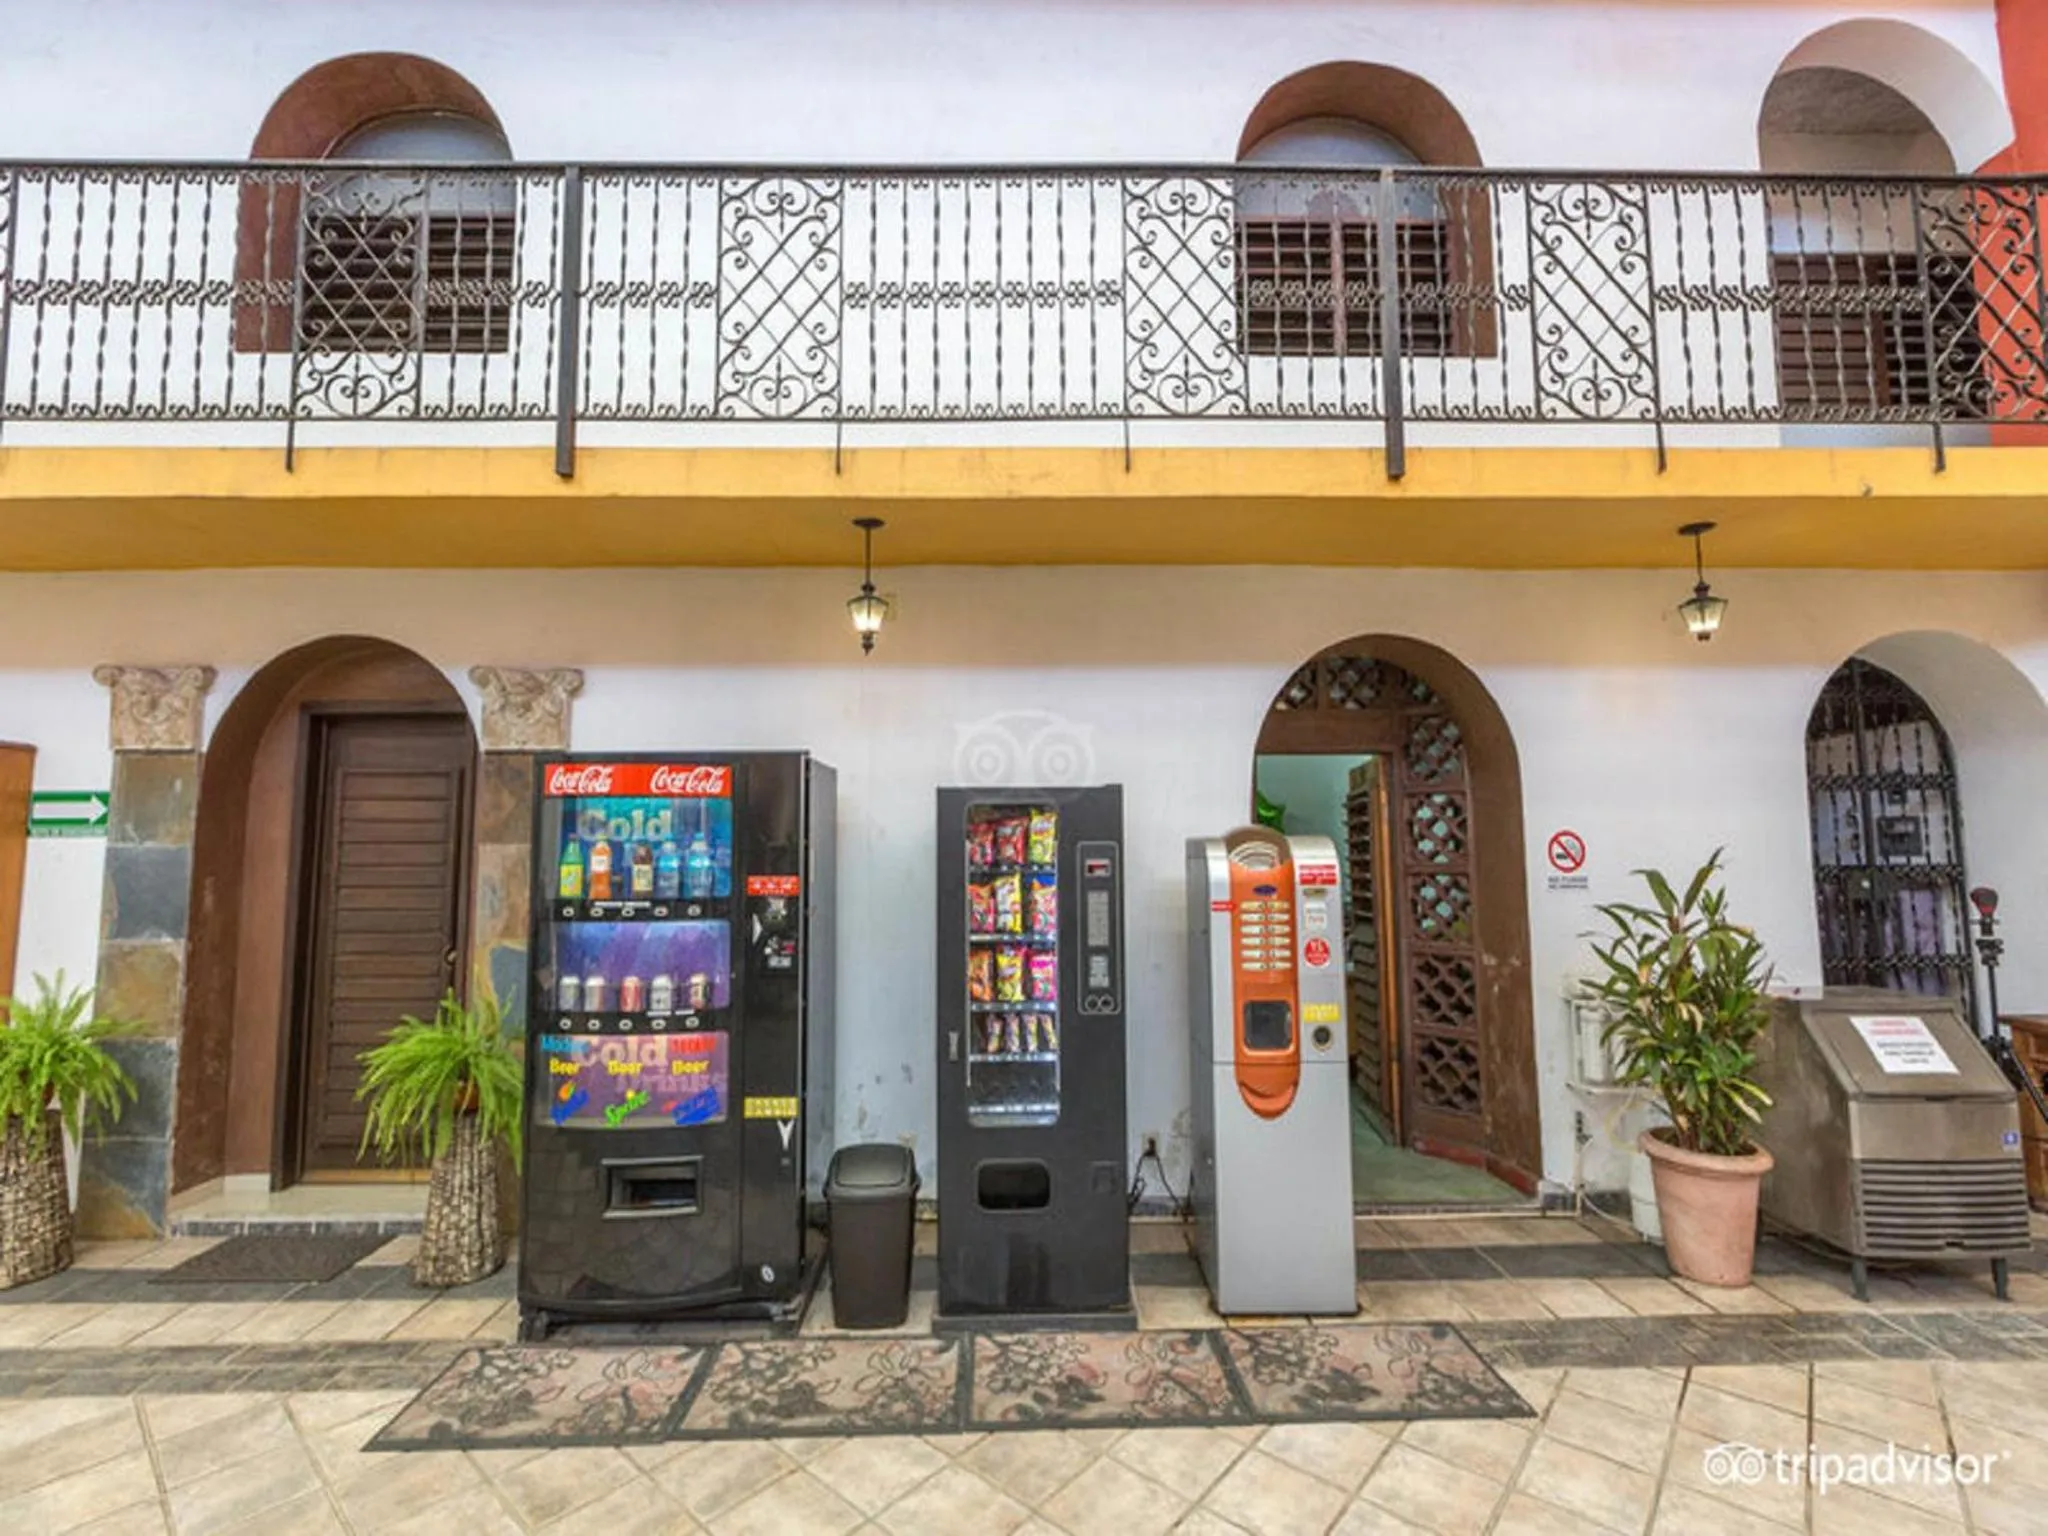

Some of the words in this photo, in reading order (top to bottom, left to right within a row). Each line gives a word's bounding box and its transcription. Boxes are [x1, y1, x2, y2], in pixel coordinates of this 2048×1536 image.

[577, 808, 672, 842] Cold
[572, 1034, 668, 1069] Cold
[548, 1056, 582, 1076] Beer
[607, 1059, 644, 1076] Beer
[670, 1059, 711, 1077] Beer
